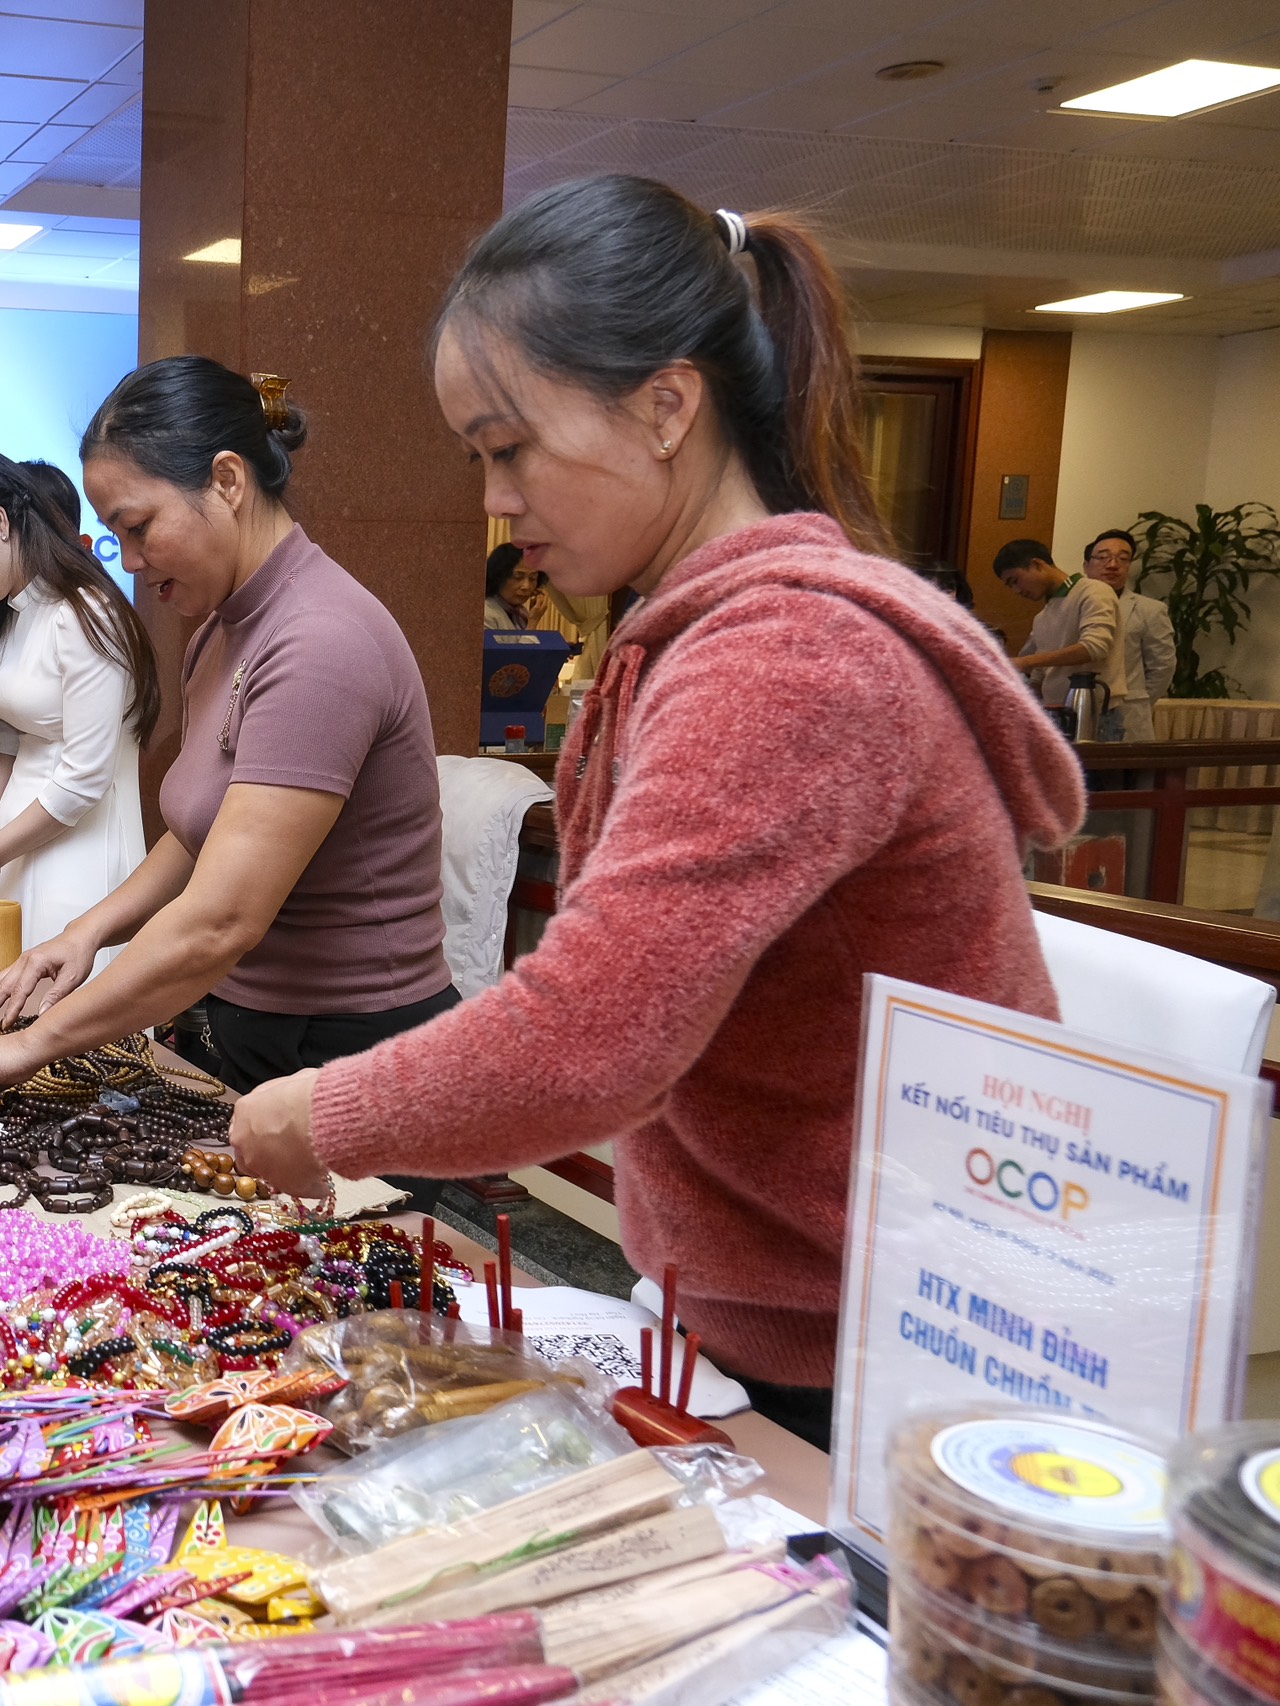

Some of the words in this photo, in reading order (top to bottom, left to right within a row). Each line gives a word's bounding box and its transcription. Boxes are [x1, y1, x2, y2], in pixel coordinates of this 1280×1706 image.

[900, 1082, 931, 1109] KẾT
[935, 1095, 970, 1124] NỐI
[975, 1109, 1015, 1138] TIÊU
[1021, 1125, 1060, 1161] THỤ
[1066, 1140, 1112, 1174] SẢN
[1118, 1161, 1190, 1202] PHẨM
[982, 1074, 1025, 1109] HỘI
[1030, 1089, 1092, 1136] NGHỊ
[965, 1147, 1091, 1220] OCOP
[918, 1267, 962, 1316] HTX
[967, 1291, 1035, 1352] MINH
